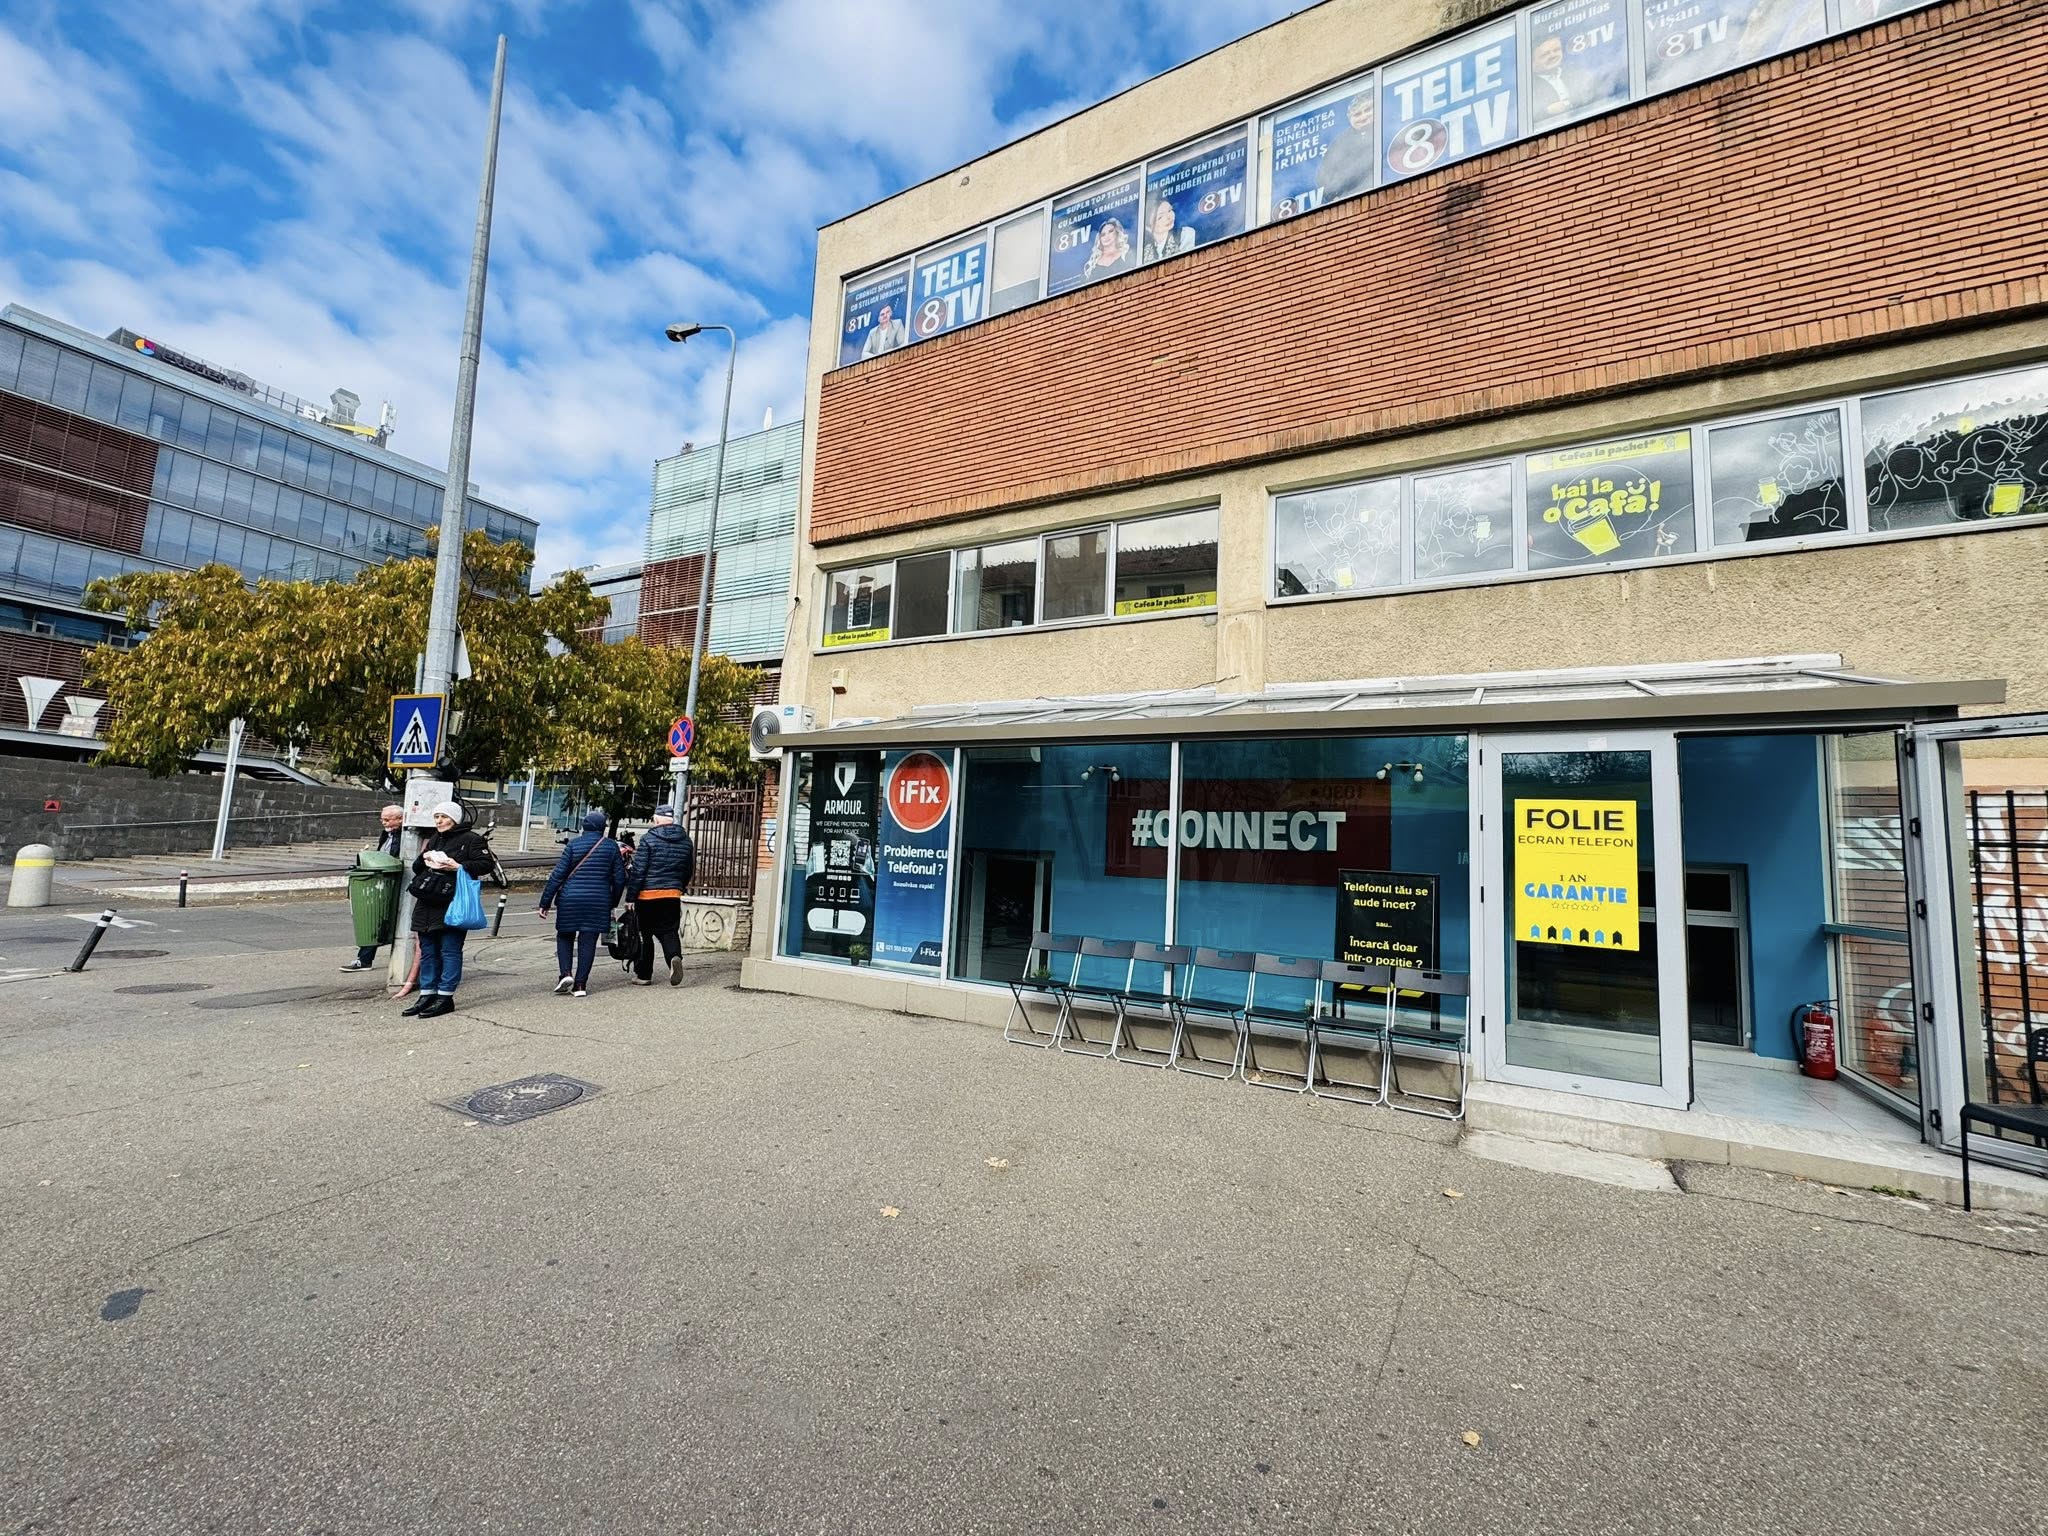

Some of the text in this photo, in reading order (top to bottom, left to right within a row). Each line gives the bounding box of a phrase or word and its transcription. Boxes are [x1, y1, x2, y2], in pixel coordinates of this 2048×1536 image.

[1394, 45, 1502, 122] TELE
[1276, 109, 1335, 138] DE PARTEA
[1276, 124, 1320, 147] BINELUI
[1275, 134, 1320, 160] PETRE
[1192, 156, 1224, 175] PENTRU
[921, 248, 981, 297] TELE
[1594, 446, 1606, 457] la
[1551, 477, 1614, 501] hai la
[1543, 506, 1562, 523] o
[899, 779, 940, 804] iFix
[1527, 808, 1624, 831] FOLIE
[1131, 809, 1347, 852] #CONNECT
[1518, 835, 1634, 848] ECRAN TELEFON
[883, 845, 948, 859] Probleme cu
[888, 860, 944, 876] Telefonul ?
[1568, 874, 1587, 882] AN
[1343, 882, 1428, 896] Telefonul tău se
[1353, 898, 1416, 910] aude încet?
[1349, 935, 1418, 952] Încarcă doar
[1343, 951, 1373, 963] într-o
[1416, 959, 1423, 969] ?
